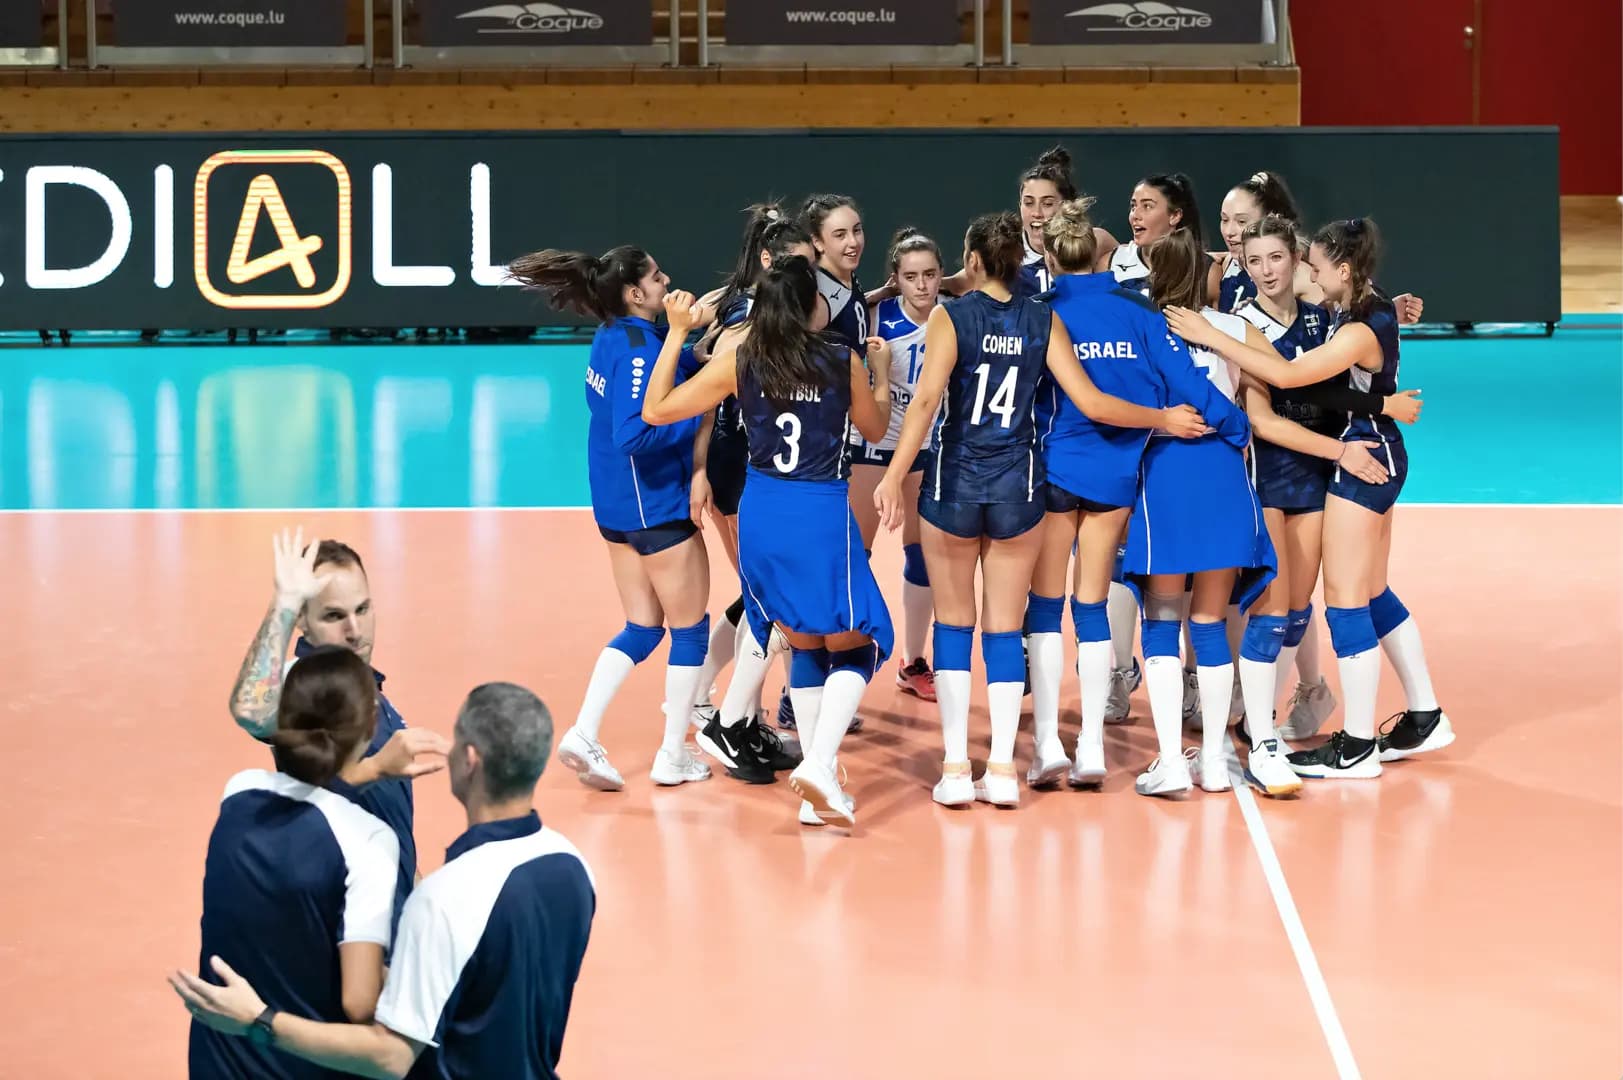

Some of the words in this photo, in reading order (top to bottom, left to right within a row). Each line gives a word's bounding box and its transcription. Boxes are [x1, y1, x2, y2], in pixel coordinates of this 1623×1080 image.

[175, 10, 285, 27] www.coque.lu
[786, 8, 896, 25] www.coque.lu
[854, 300, 867, 345] 8
[982, 333, 1023, 356] COHEN
[970, 363, 1020, 429] 14
[773, 412, 802, 474] 3
